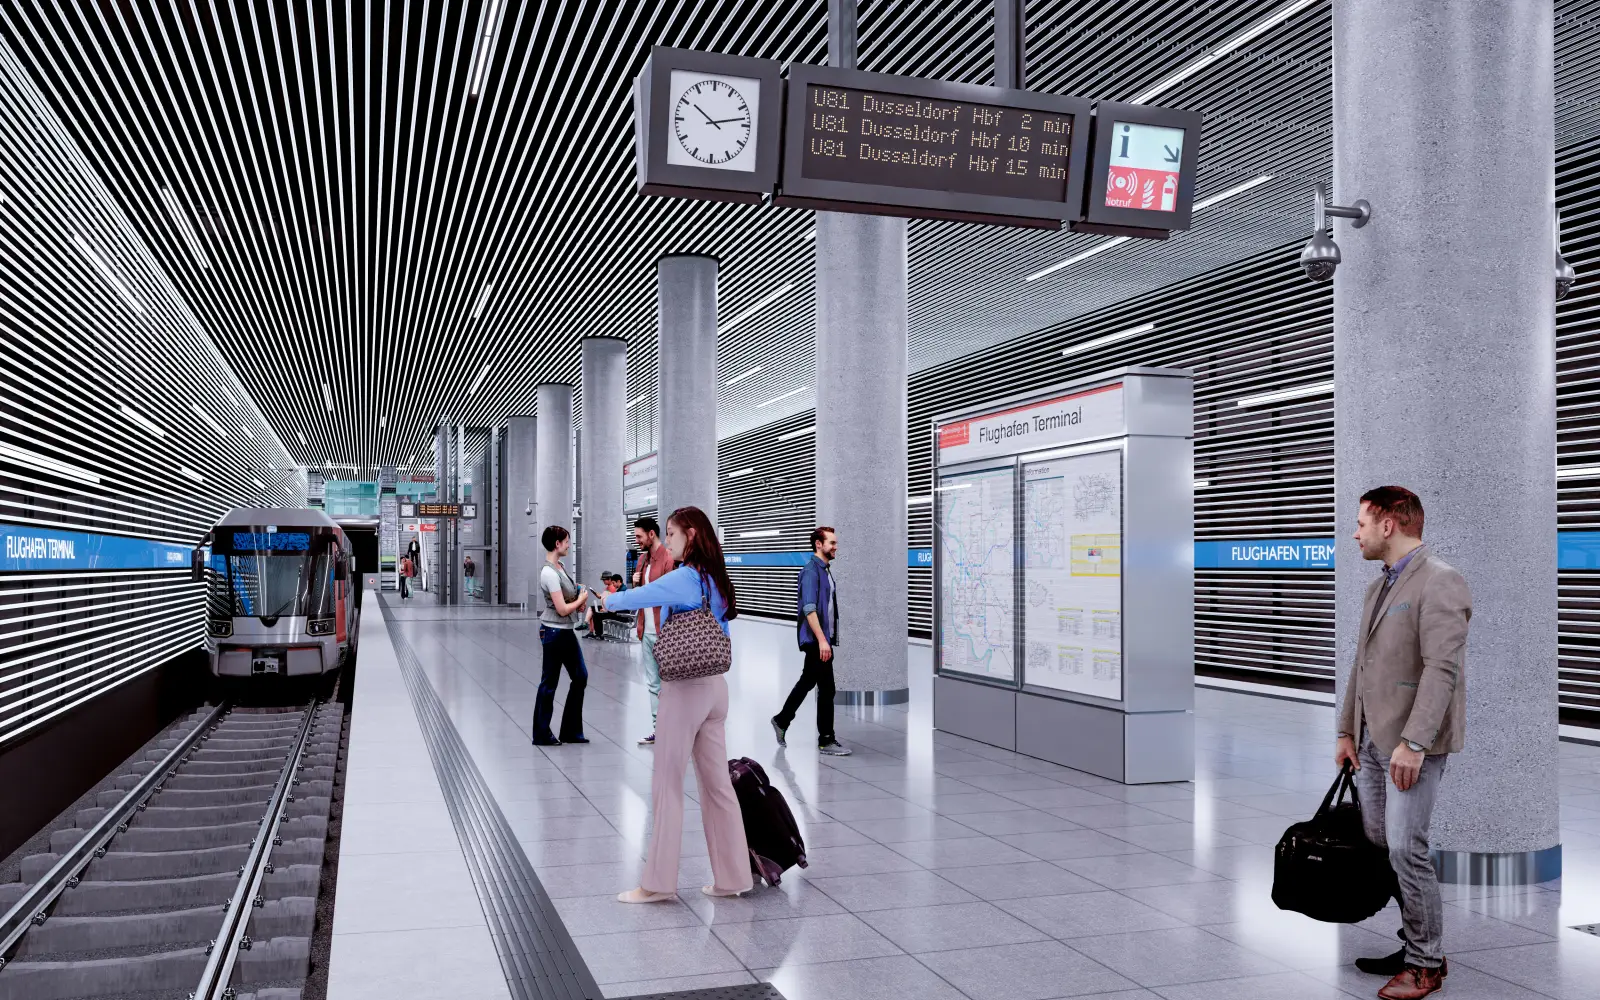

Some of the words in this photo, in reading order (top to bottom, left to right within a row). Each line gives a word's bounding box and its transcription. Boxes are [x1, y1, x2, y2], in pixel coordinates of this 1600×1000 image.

[814, 89, 850, 110] U81
[863, 95, 961, 122] Dusseldorf
[973, 107, 1003, 127] Hbf
[1021, 113, 1032, 130] 2
[1043, 117, 1071, 135] min
[812, 113, 848, 133] U81
[861, 118, 960, 145] Dusseldorf
[970, 130, 1001, 149] Hbf
[1007, 135, 1030, 152] 10
[1041, 140, 1069, 157] min
[811, 138, 847, 158] U81
[859, 143, 958, 168] Dusseldorf
[968, 154, 999, 172] Hbf
[1005, 158, 1028, 175] 15
[1039, 163, 1066, 180] min
[1105, 196, 1132, 207] Notruf
[979, 419, 1029, 444] Flughafen
[1032, 406, 1082, 432] Terminal
[6, 535, 47, 559] FLUGHAFEN
[47, 538, 76, 559] TERMINAL
[1231, 545, 1300, 561] FLUGHAFEN
